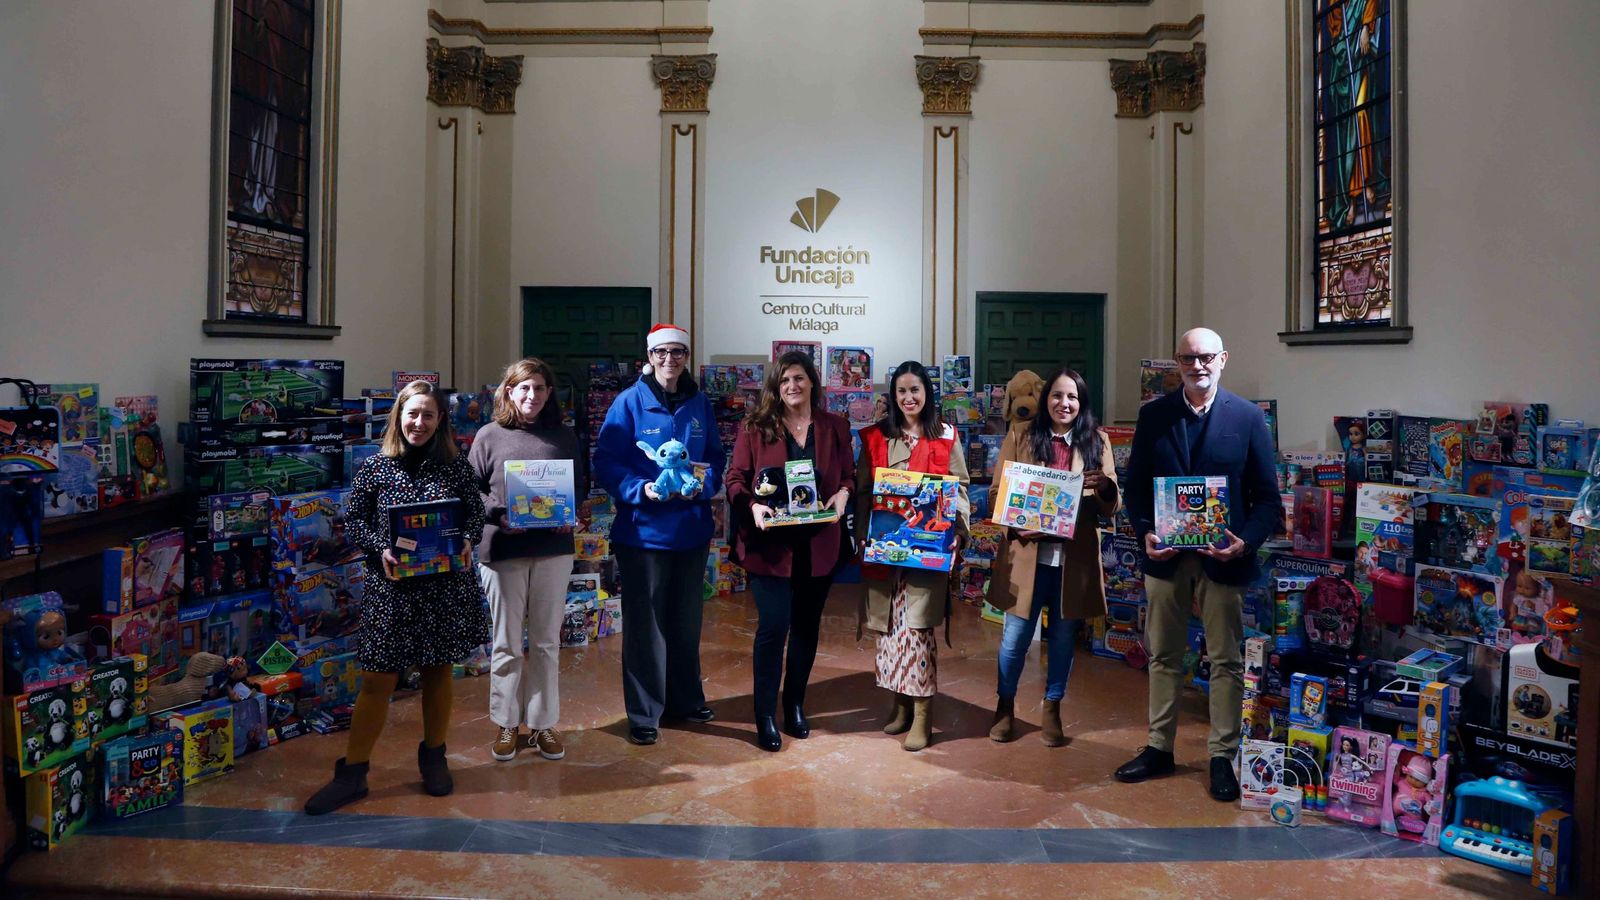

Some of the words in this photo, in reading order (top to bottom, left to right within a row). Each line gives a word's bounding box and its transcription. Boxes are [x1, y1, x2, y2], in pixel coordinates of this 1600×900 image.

[760, 245, 870, 264] Fundación
[775, 266, 855, 288] Unicaja
[762, 302, 810, 315] Centro
[812, 302, 866, 316] Cultural
[789, 318, 839, 334] Málaga
[198, 361, 235, 369] playmobil
[201, 449, 237, 458] playmobil
[1022, 467, 1067, 481] abecedario
[1177, 485, 1204, 494] PARTY
[403, 512, 449, 529] TETRIS
[1383, 523, 1401, 533] 110
[1164, 534, 1224, 545] FAMILY
[264, 657, 292, 666] PISTAS
[92, 669, 119, 681] CREATOR
[30, 692, 53, 704] CREAT
[131, 747, 160, 761] PARTY
[1476, 737, 1561, 763] BEYBLADE
[1331, 778, 1376, 799] twinning
[115, 792, 177, 817] FAMILY
